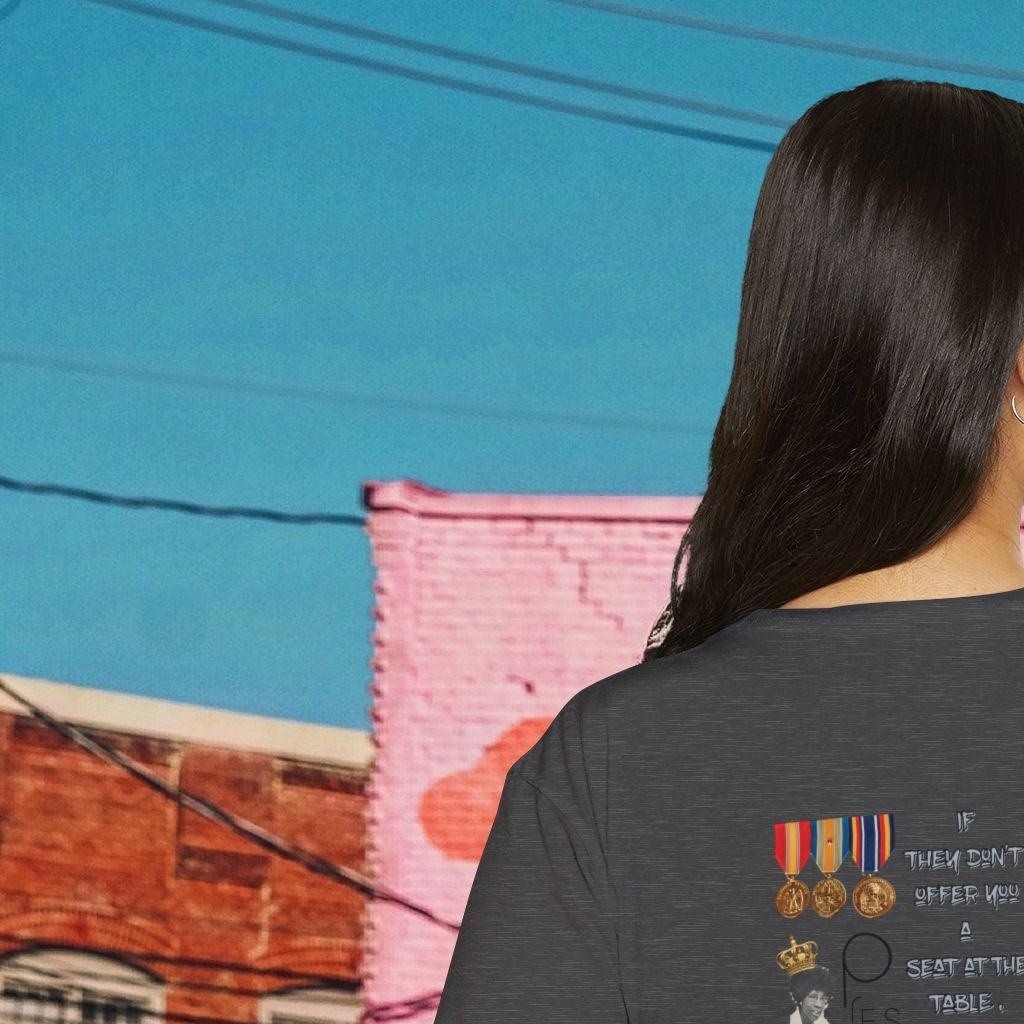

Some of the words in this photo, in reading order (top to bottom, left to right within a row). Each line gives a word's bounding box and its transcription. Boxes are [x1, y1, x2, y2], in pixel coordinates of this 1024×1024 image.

[957, 811, 976, 833] IF
[904, 848, 961, 876] THEY
[966, 844, 1024, 868] DON'T
[915, 884, 979, 907] OFFER
[985, 883, 1020, 911] YOU
[960, 921, 973, 942] A
[907, 957, 961, 980] SEAT
[964, 956, 989, 979] AT
